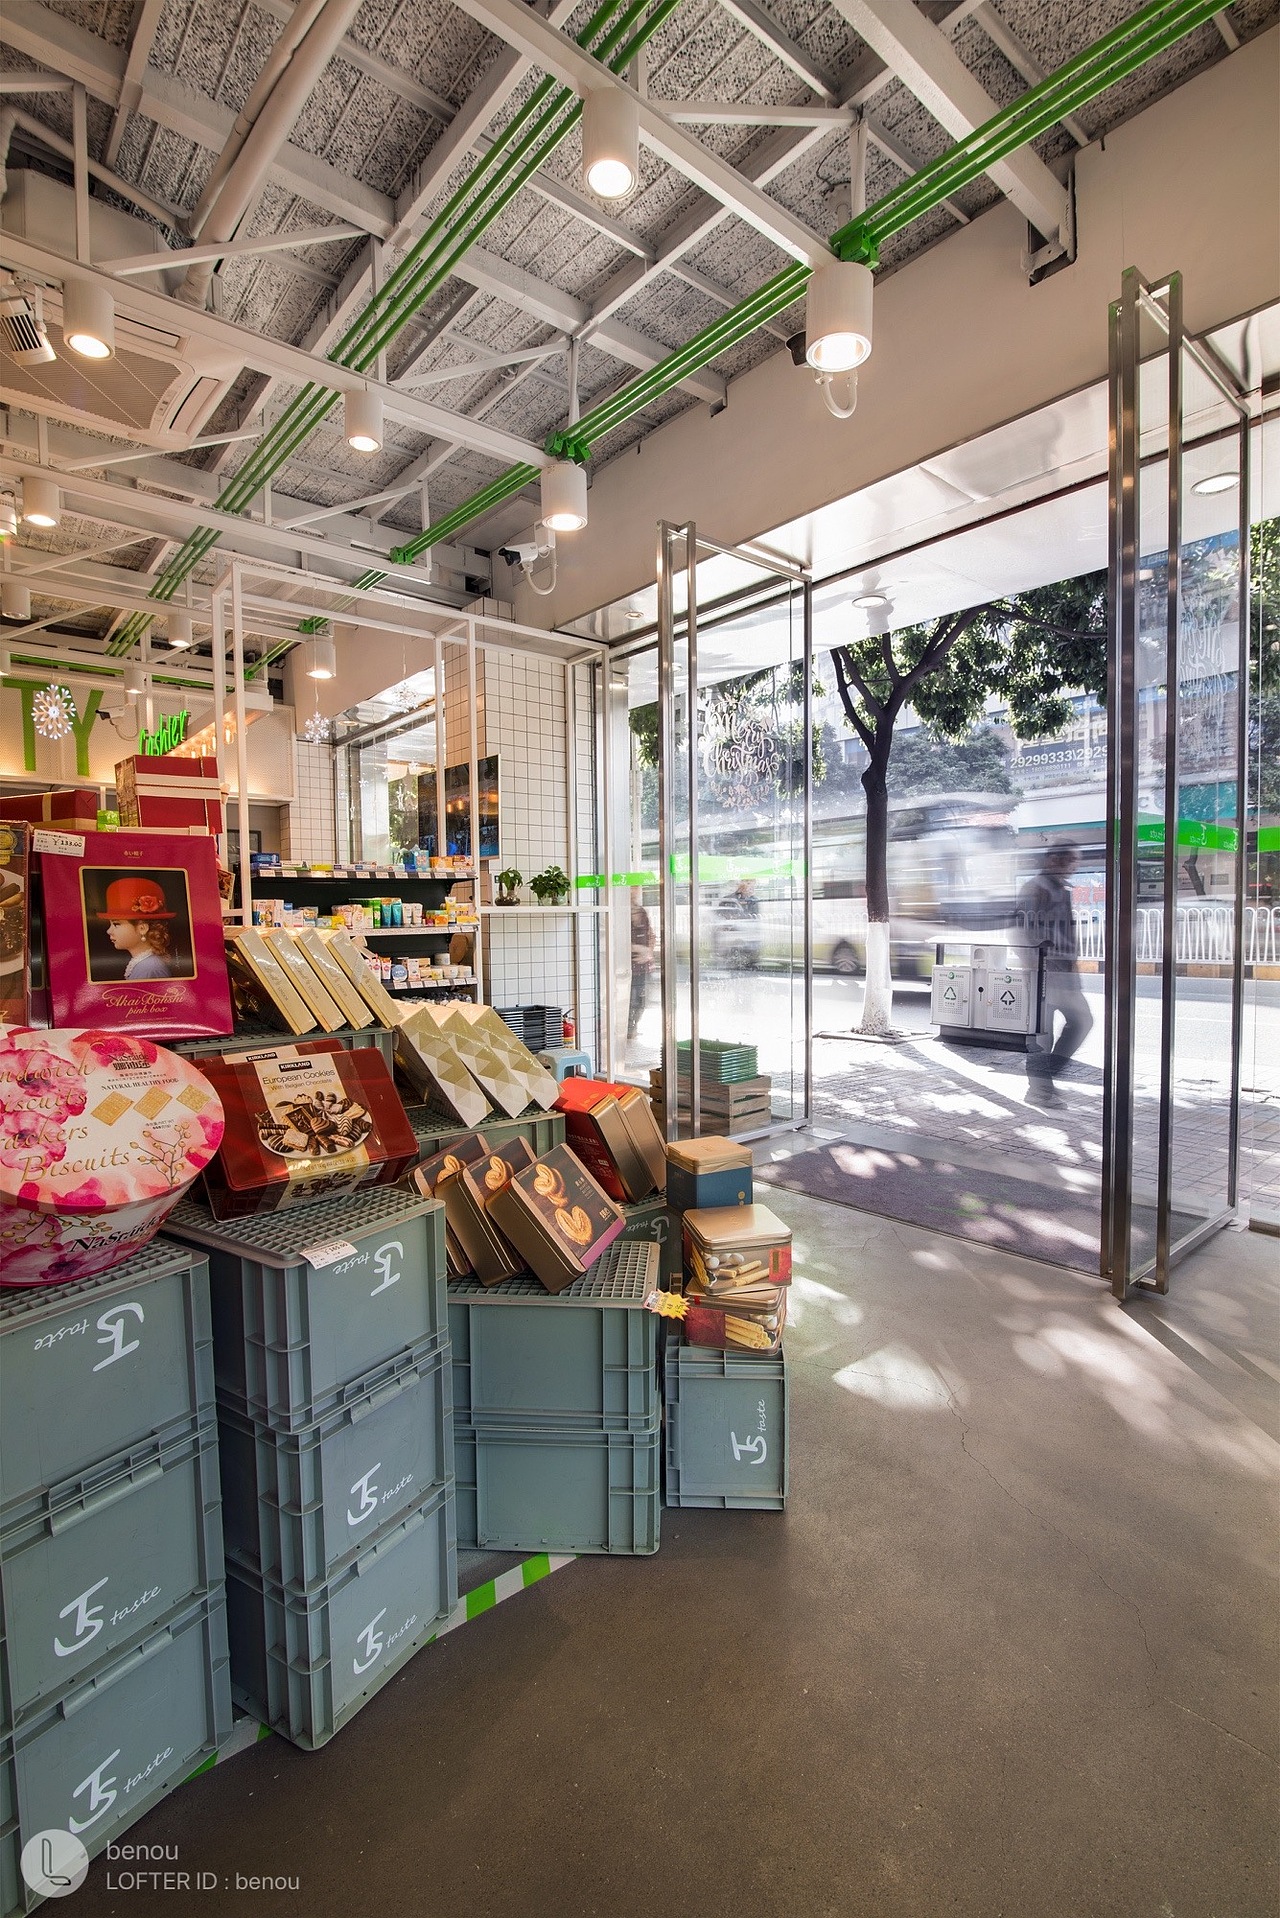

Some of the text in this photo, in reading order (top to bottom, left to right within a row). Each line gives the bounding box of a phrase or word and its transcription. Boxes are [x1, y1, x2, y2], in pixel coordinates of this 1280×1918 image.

[703, 711, 775, 758] Merry
[698, 736, 779, 786] Christmas
[104, 991, 141, 1007] Akai
[126, 1004, 168, 1018] pink box
[247, 1052, 278, 1062] KIRKLAND
[280, 1060, 312, 1071] KIRKLAND
[101, 1082, 132, 1091] NATURAL
[262, 1069, 336, 1085] European Cookies
[285, 1081, 305, 1090] Belgian
[19, 1146, 131, 1183] Biscuits
[332, 1252, 371, 1275] taste
[33, 1318, 90, 1351] taste
[756, 1399, 767, 1433] taste
[381, 1473, 414, 1504] taste
[109, 1586, 162, 1626] taste
[386, 1614, 418, 1649] taste
[123, 1746, 174, 1794] taste
